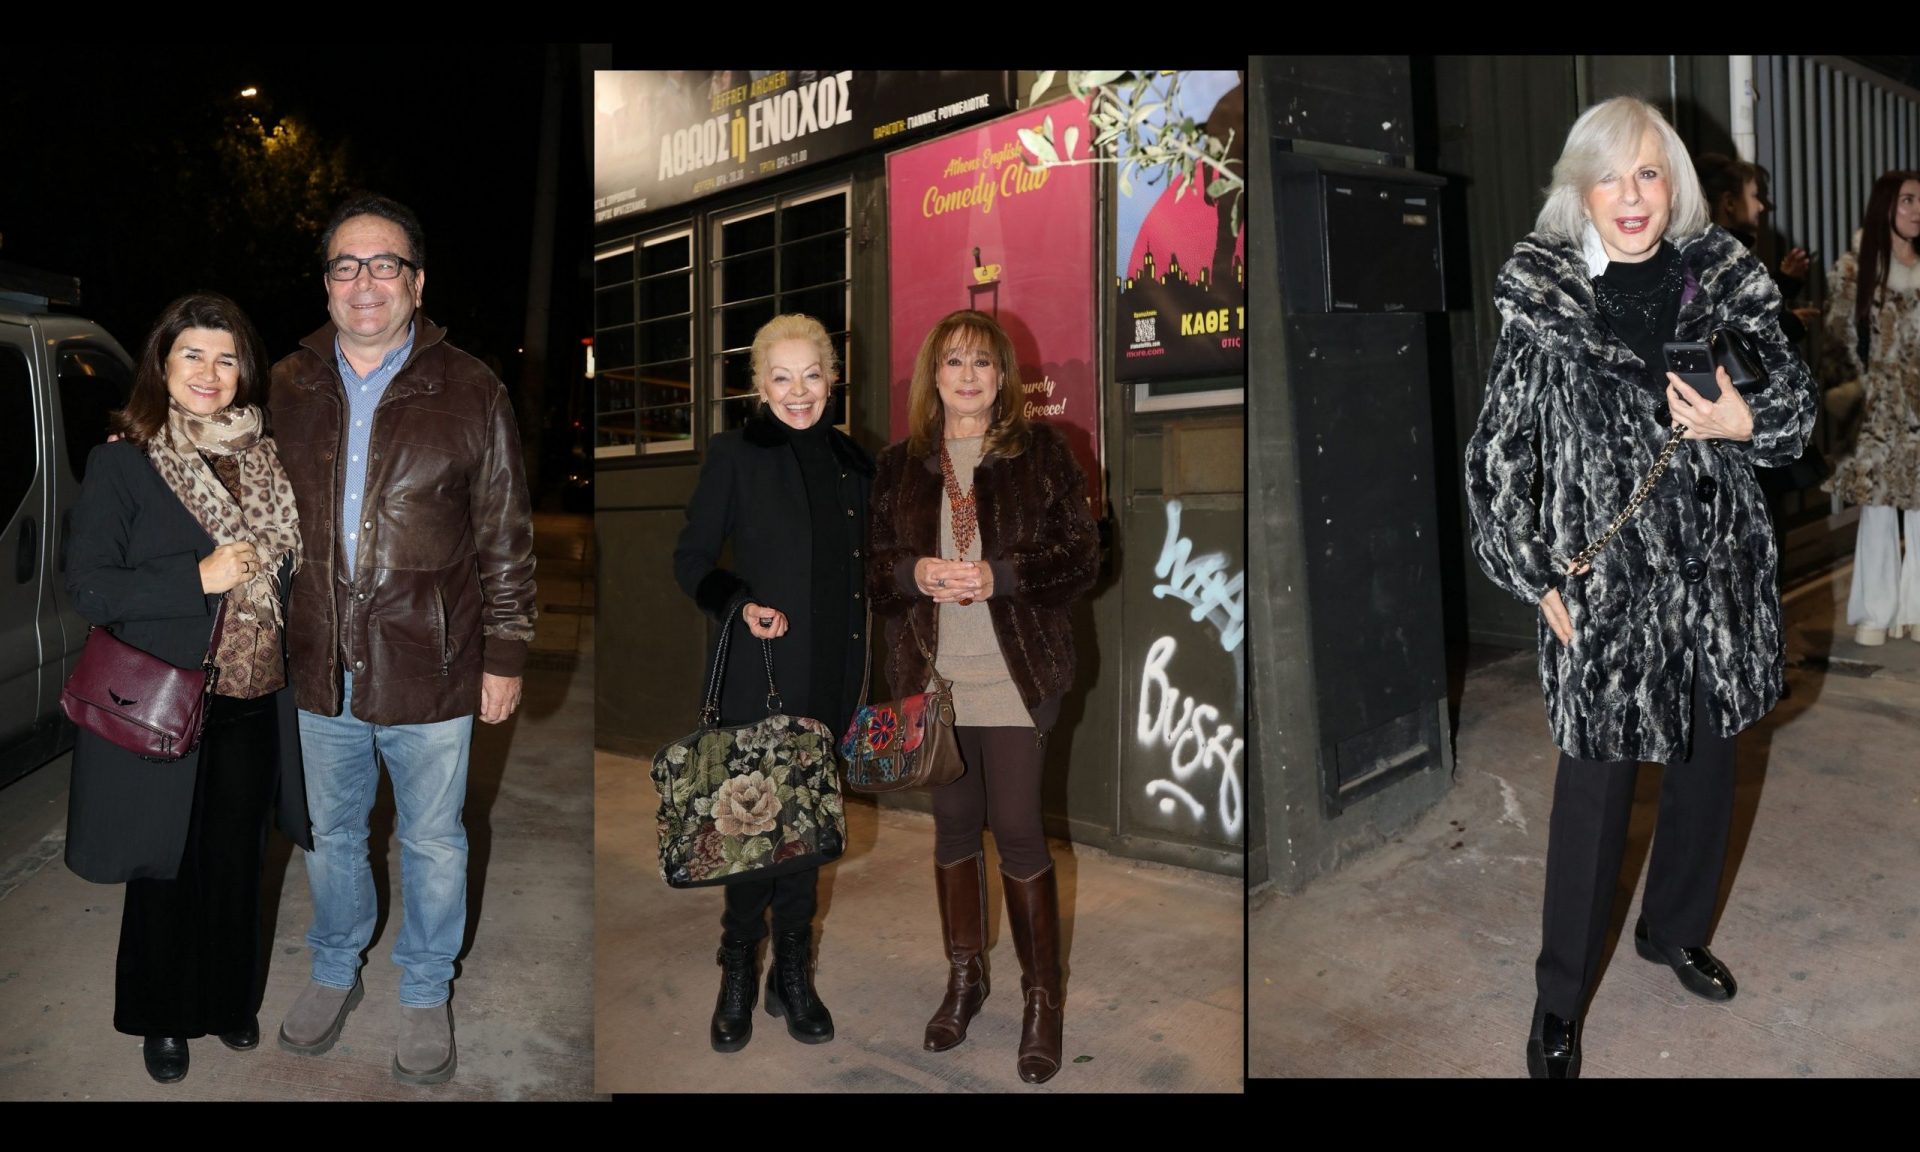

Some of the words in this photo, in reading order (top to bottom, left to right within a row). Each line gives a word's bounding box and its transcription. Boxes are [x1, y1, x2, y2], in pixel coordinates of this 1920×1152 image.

[711, 84, 748, 113] JEFFREY
[751, 71, 788, 98] ARCHER
[658, 113, 730, 182] ΑΘΩΟΣ
[748, 70, 853, 153] ΕΝΟΧΟΣ
[943, 156, 980, 179] Athens
[983, 140, 1023, 170] English
[923, 172, 999, 218] Comedy
[1000, 160, 1051, 198] Club
[1181, 308, 1229, 336] ΚΑΘΕ
[1023, 397, 1067, 420] Greece!
